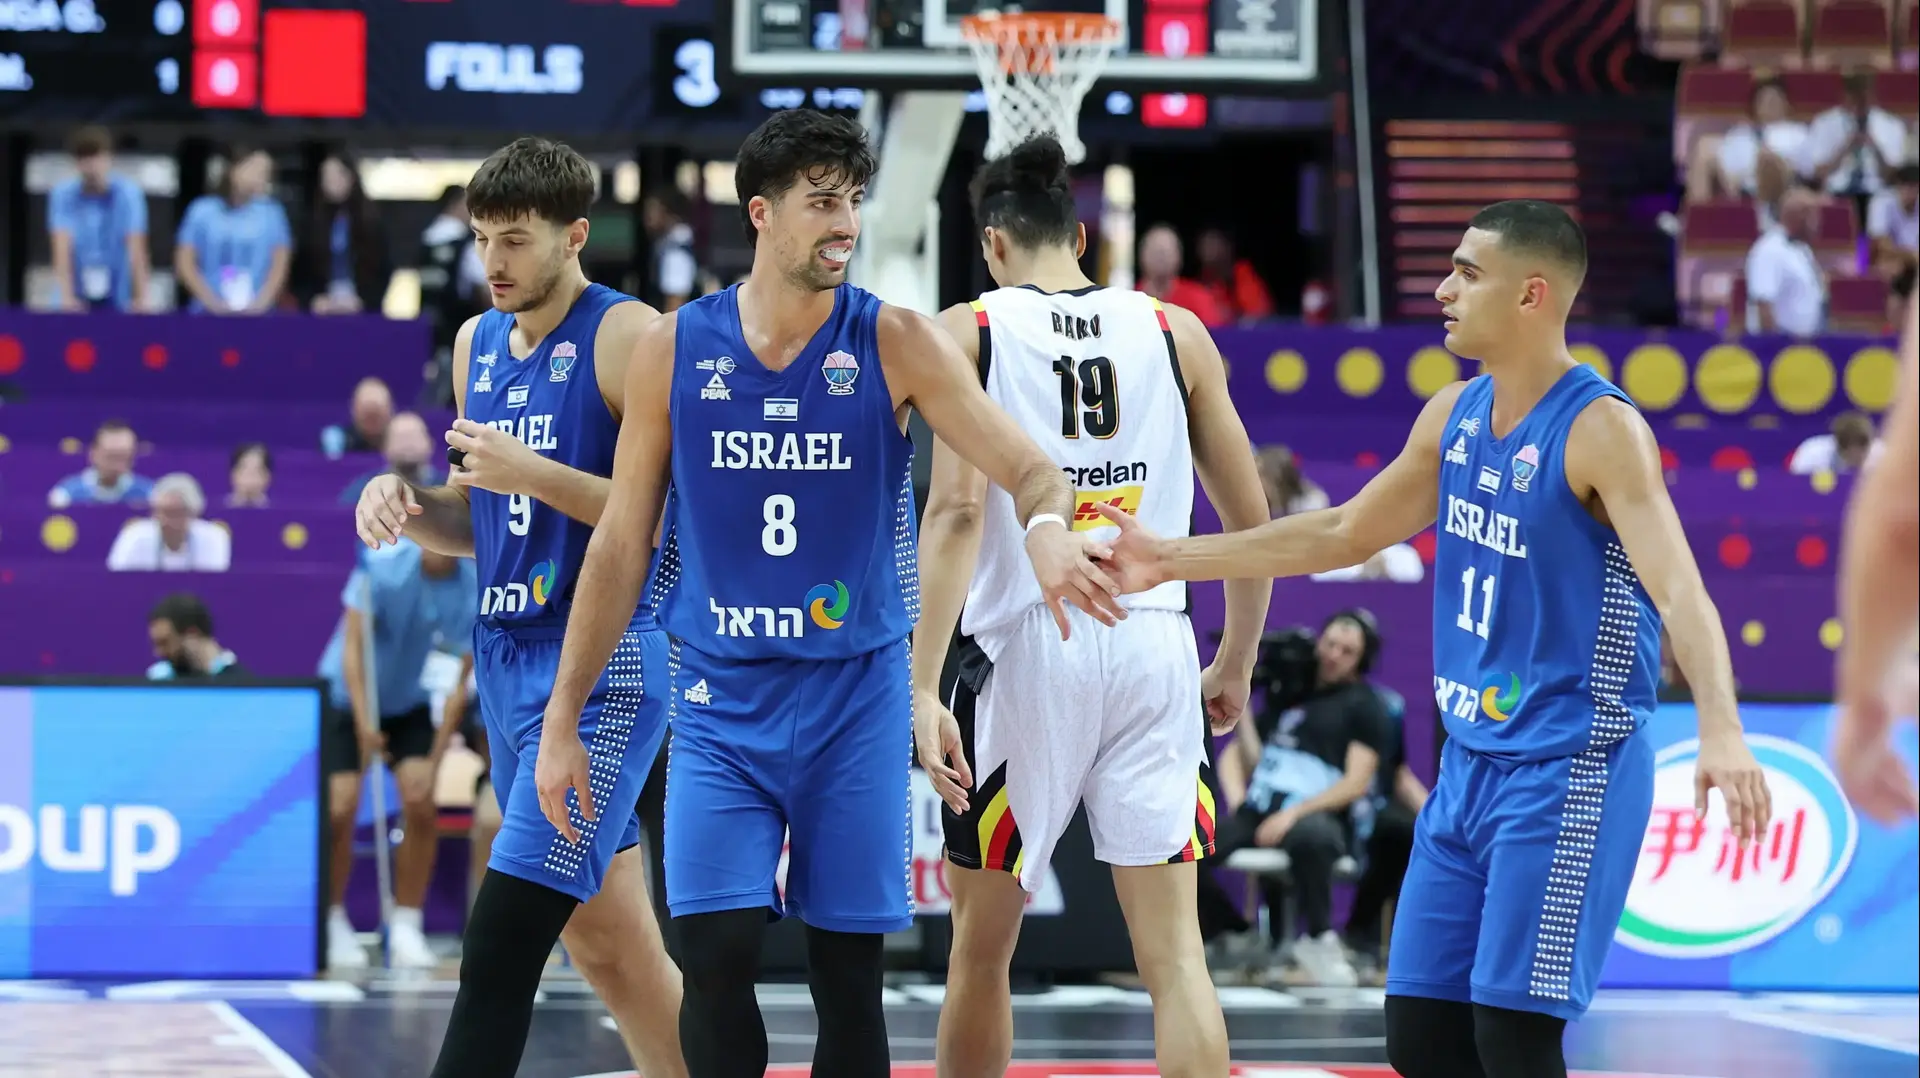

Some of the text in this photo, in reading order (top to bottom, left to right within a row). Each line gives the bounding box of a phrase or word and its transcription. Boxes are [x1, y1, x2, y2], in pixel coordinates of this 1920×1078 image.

[426, 39, 720, 107] FOULS 3
[700, 387, 732, 400] PEAK
[1053, 355, 1120, 439] 19
[478, 414, 558, 450] RAEL
[711, 430, 852, 470] ISRAEL
[508, 493, 531, 536] 9
[761, 494, 798, 556] 8
[1073, 497, 1129, 521] HL
[1445, 495, 1527, 559] ISRAEL
[709, 597, 804, 638] הראל
[1457, 566, 1496, 641] 11
[684, 688, 713, 706] PEAK
[1433, 674, 1480, 723] הרא
